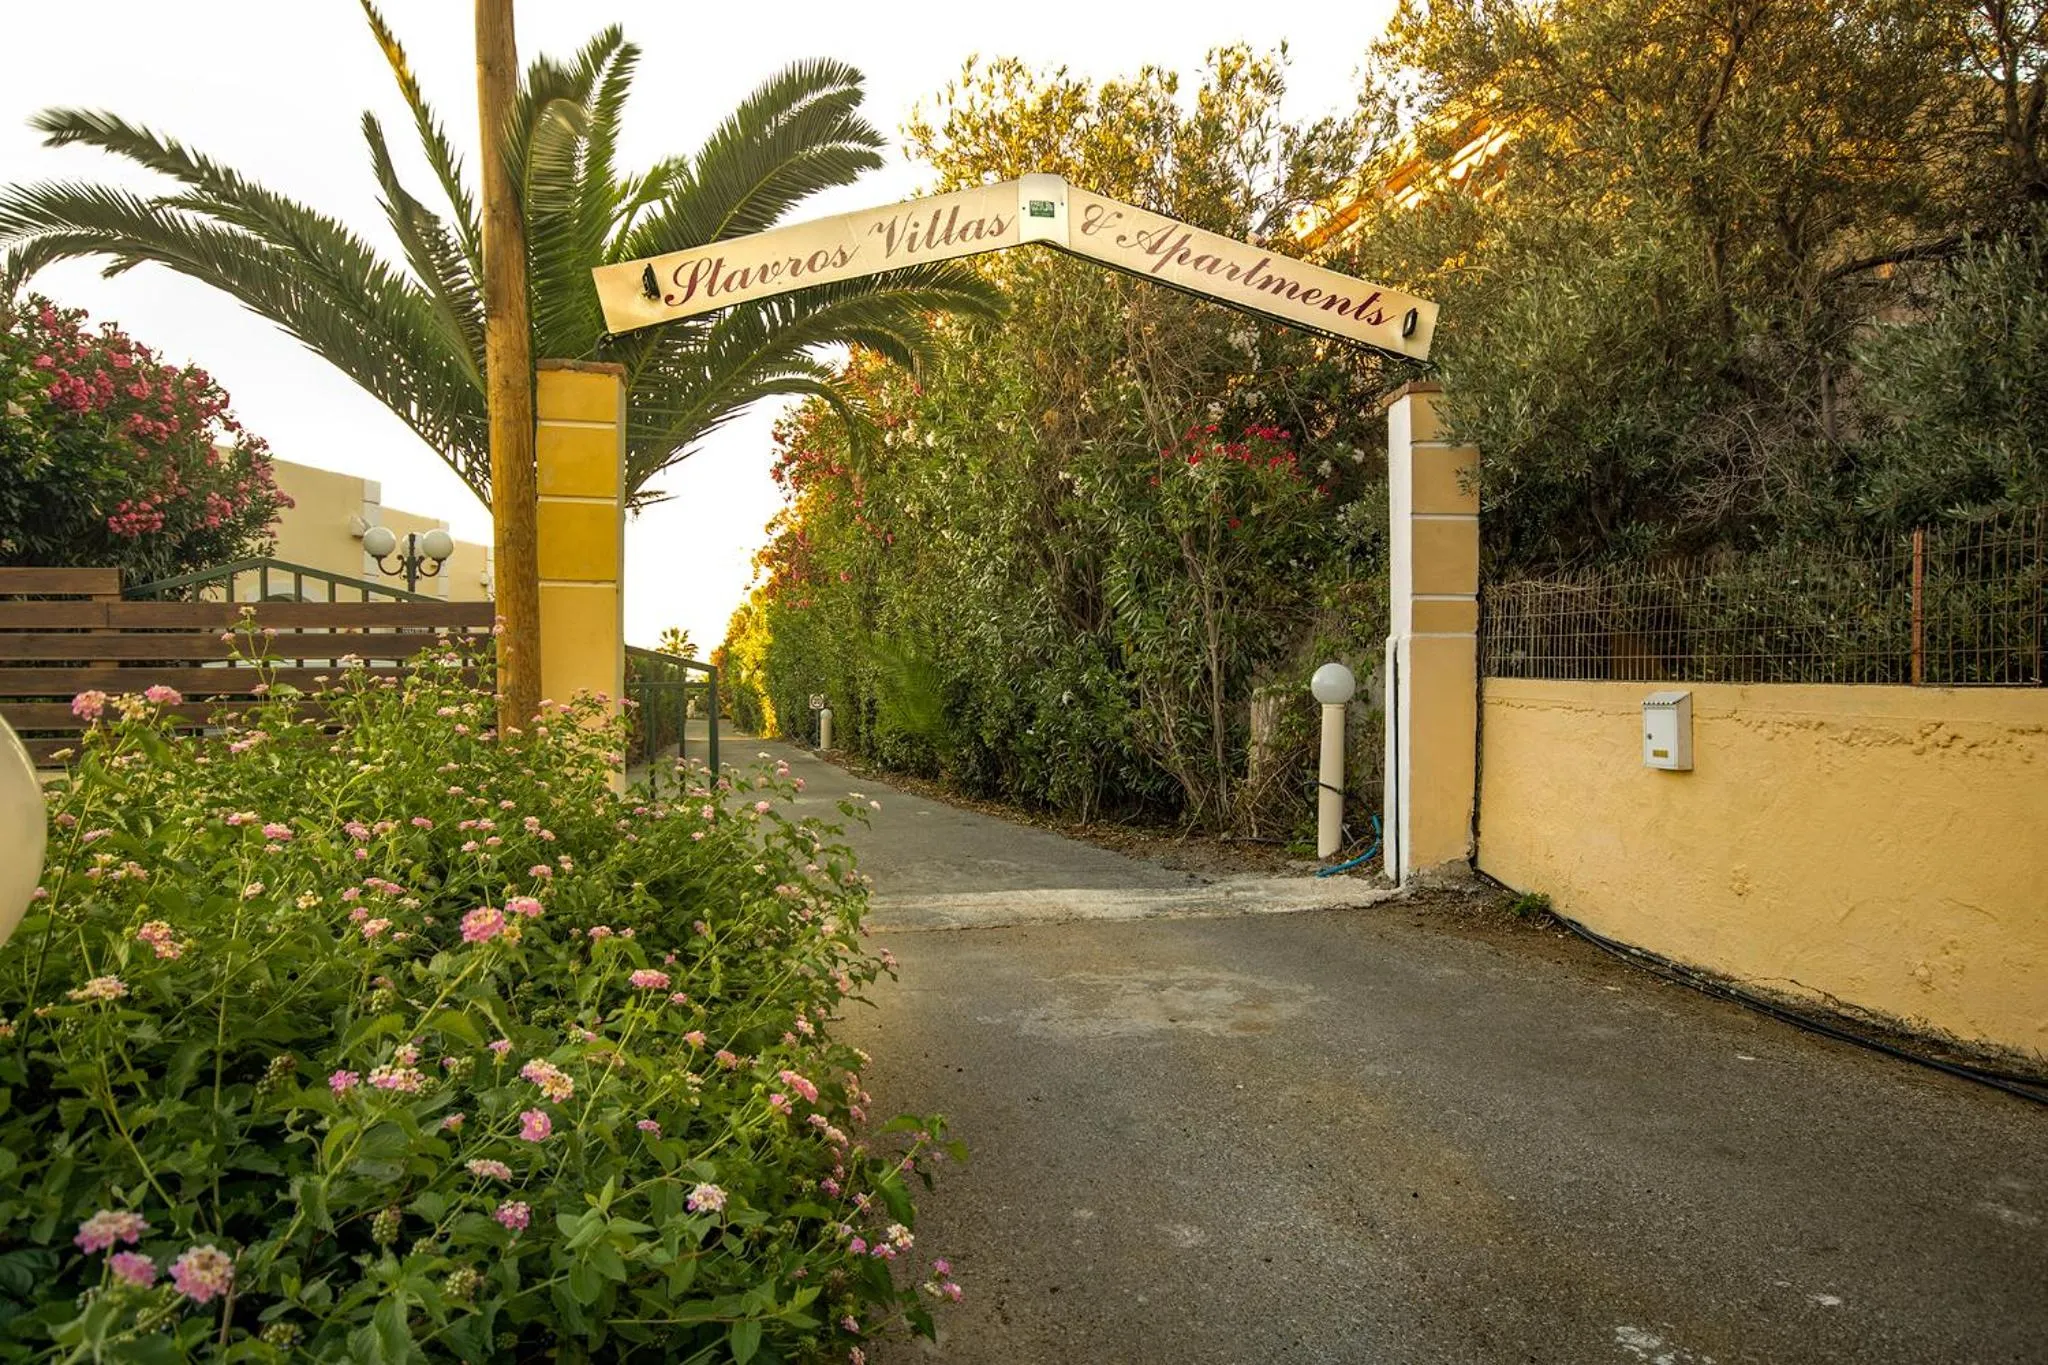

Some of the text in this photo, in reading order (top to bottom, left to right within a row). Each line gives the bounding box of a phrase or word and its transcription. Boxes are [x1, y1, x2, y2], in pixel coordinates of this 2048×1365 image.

[665, 205, 1396, 325] Stavros Villas & Apartments
